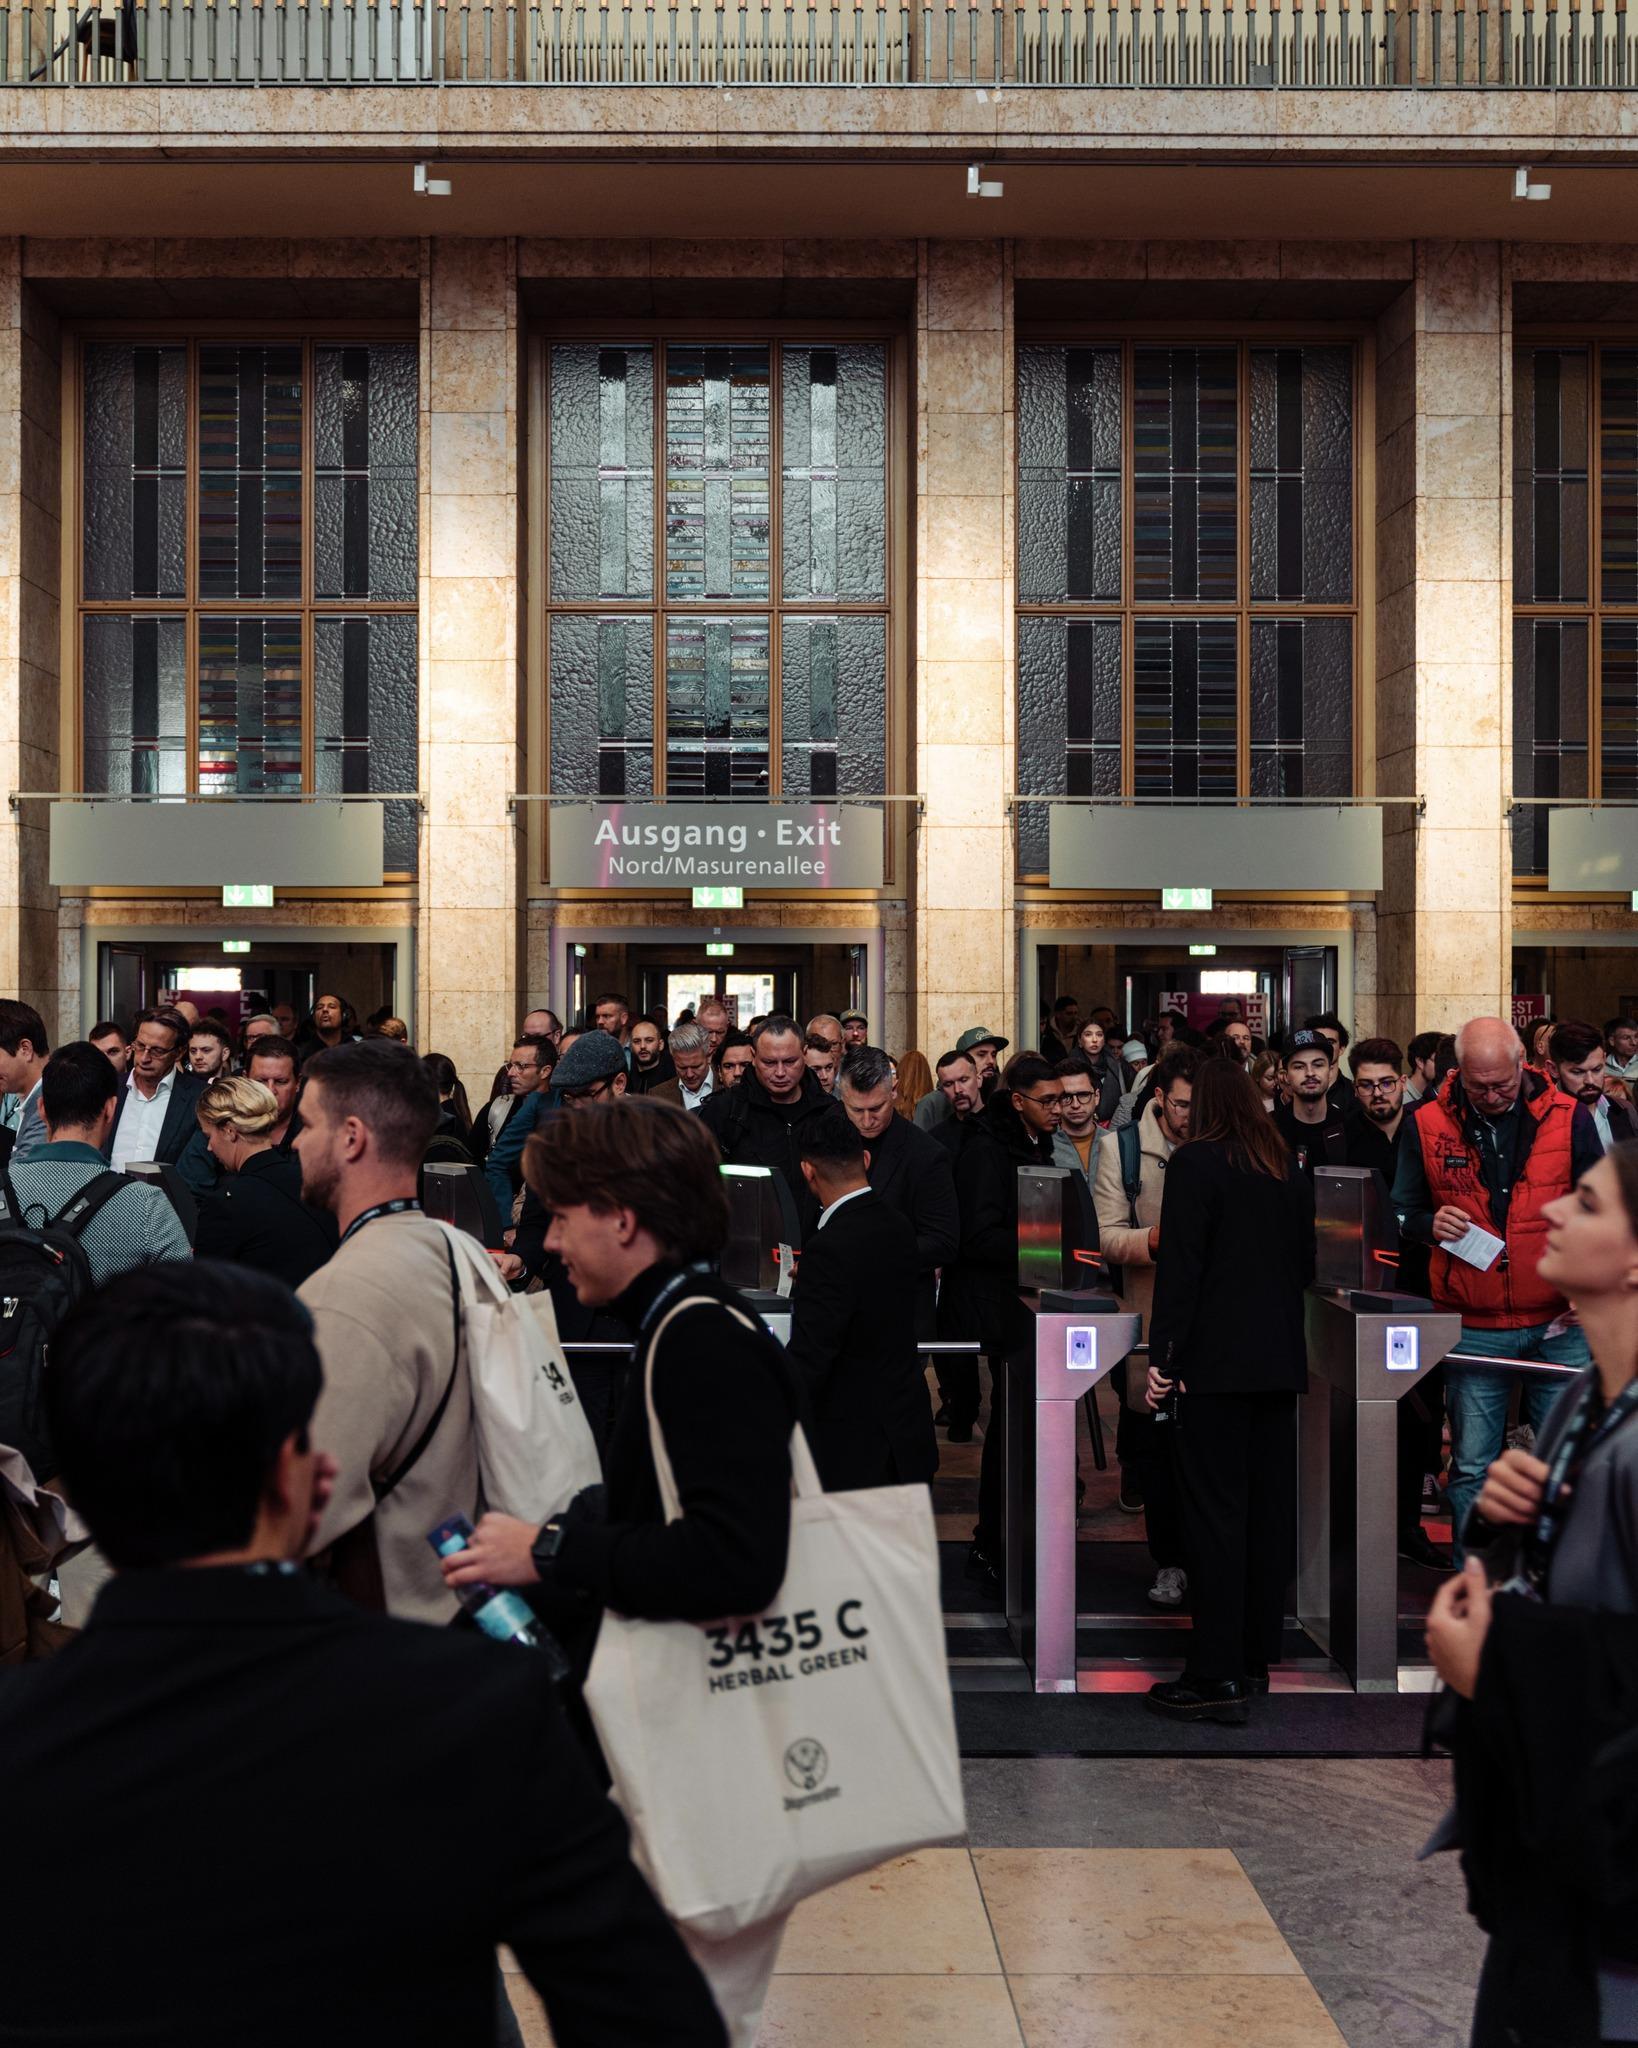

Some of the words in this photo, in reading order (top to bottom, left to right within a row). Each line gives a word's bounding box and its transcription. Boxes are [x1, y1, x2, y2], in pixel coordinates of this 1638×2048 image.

[594, 819, 748, 853] Ausgang
[776, 819, 841, 846] Exit
[609, 856, 826, 875] Nord/Masurenallee
[705, 1609, 822, 1668] 3435
[837, 1600, 868, 1640] C
[708, 1664, 794, 1694] HERBAL
[799, 1645, 868, 1676] GREEN
